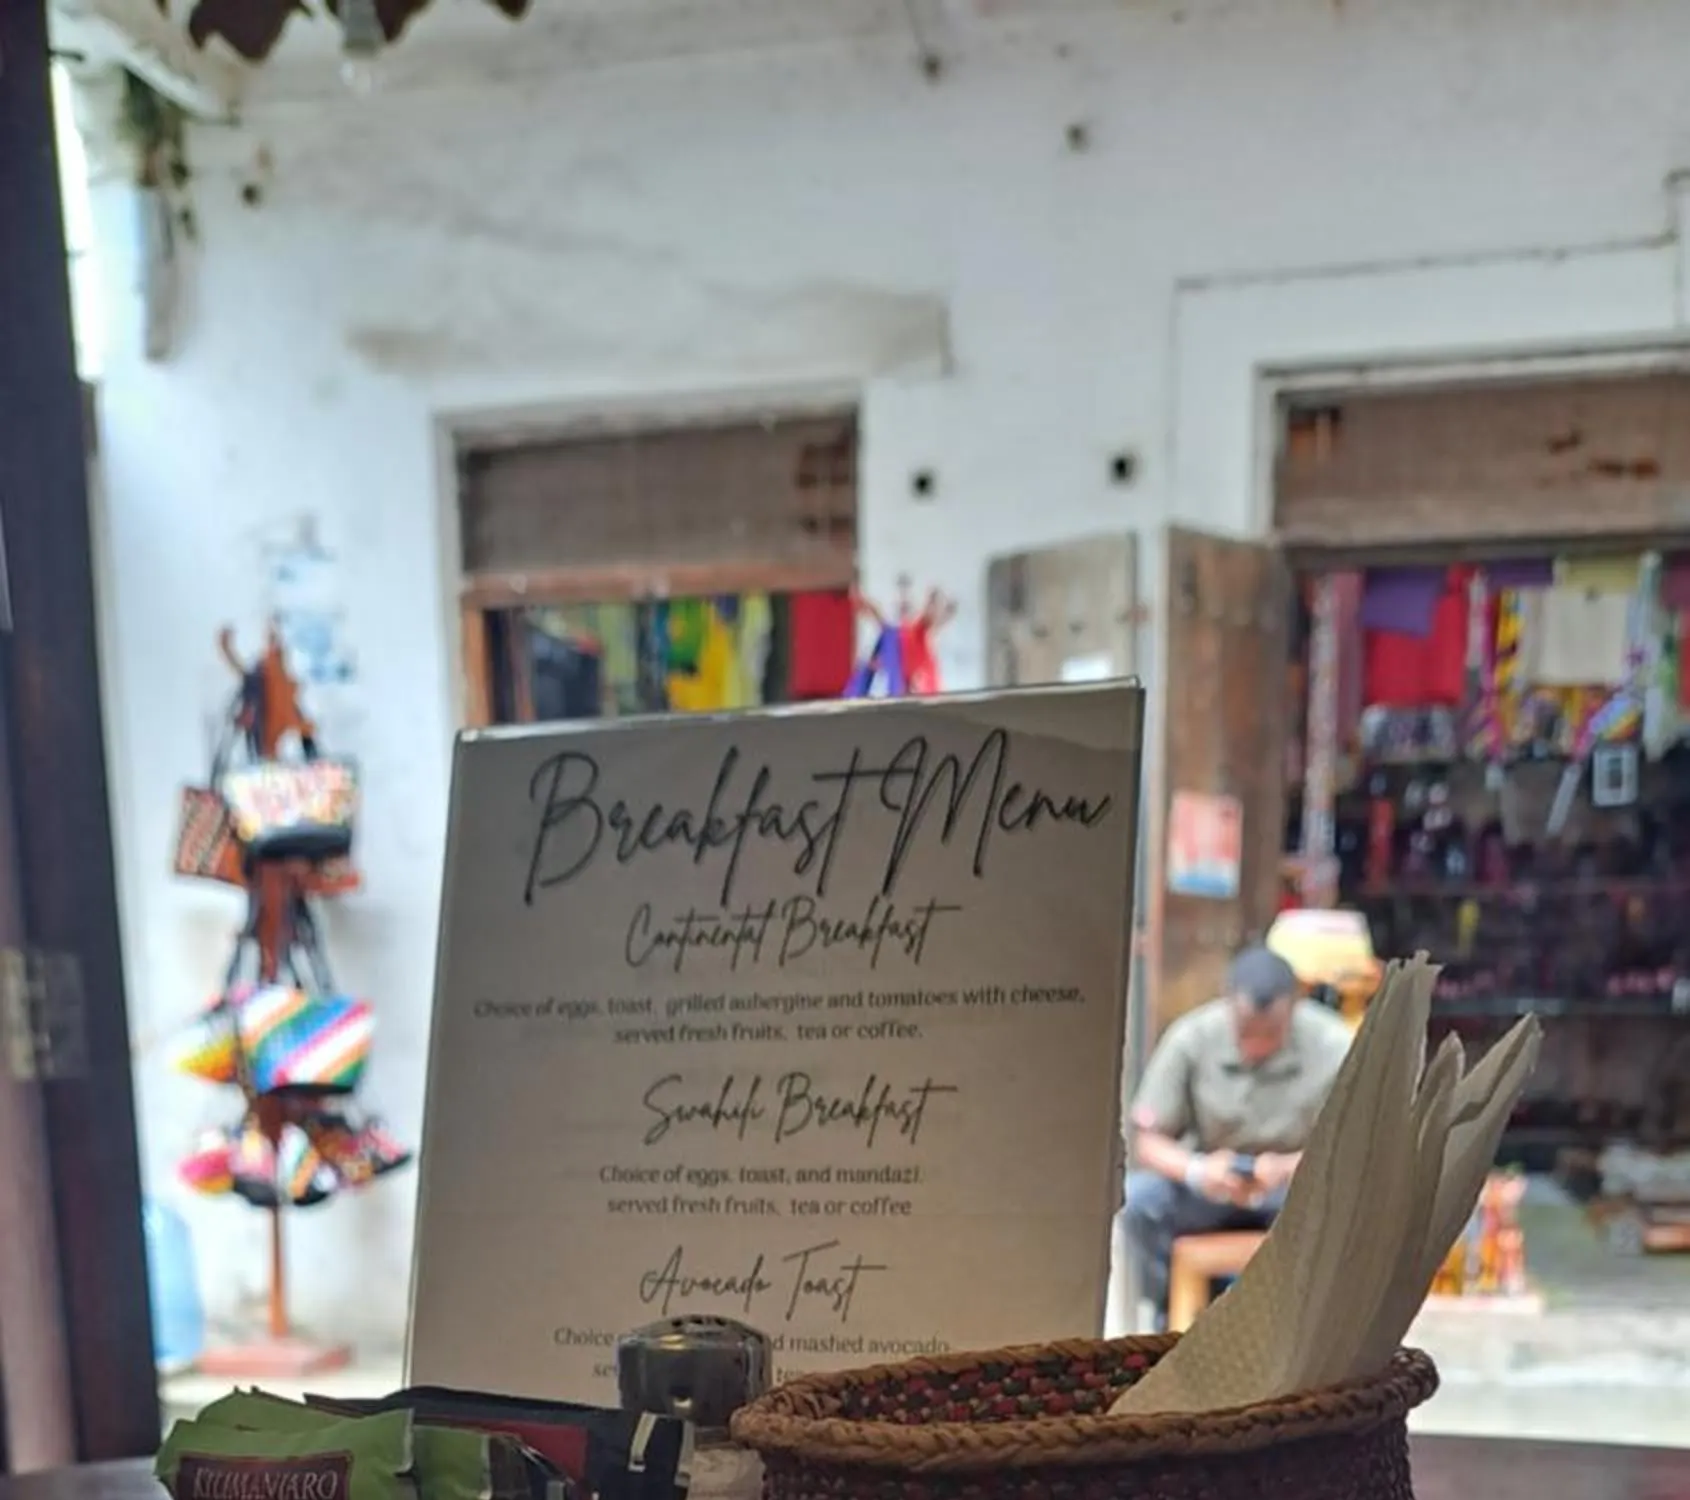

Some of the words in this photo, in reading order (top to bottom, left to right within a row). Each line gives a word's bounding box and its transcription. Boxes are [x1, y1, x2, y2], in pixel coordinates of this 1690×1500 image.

[523, 745, 915, 907] Breakfast
[880, 727, 1111, 896] Menu
[626, 899, 778, 973] Continental
[779, 894, 961, 970] Breakfast
[473, 999, 532, 1019] Choice
[535, 997, 555, 1015] of
[665, 992, 726, 1017] grilled
[729, 992, 823, 1014] aubergine
[826, 991, 865, 1009] and
[867, 987, 959, 1008] tomatoes
[962, 984, 1006, 1007] with
[613, 1025, 676, 1044] served
[678, 1023, 728, 1042] fresh
[798, 1022, 827, 1040] tea
[830, 1022, 853, 1039] or
[643, 1074, 765, 1146] Swahili
[774, 1071, 958, 1148] Breakfast
[599, 1164, 661, 1185] Choice
[663, 1163, 685, 1184] of
[795, 1165, 832, 1184] and
[607, 1196, 668, 1215] served
[671, 1196, 721, 1213] fresh
[790, 1198, 820, 1215] tea
[823, 1198, 849, 1215] or
[639, 1244, 771, 1317] Avocado
[782, 1239, 888, 1323] Toast
[553, 1327, 614, 1348] Choice
[789, 1334, 864, 1354] mashed
